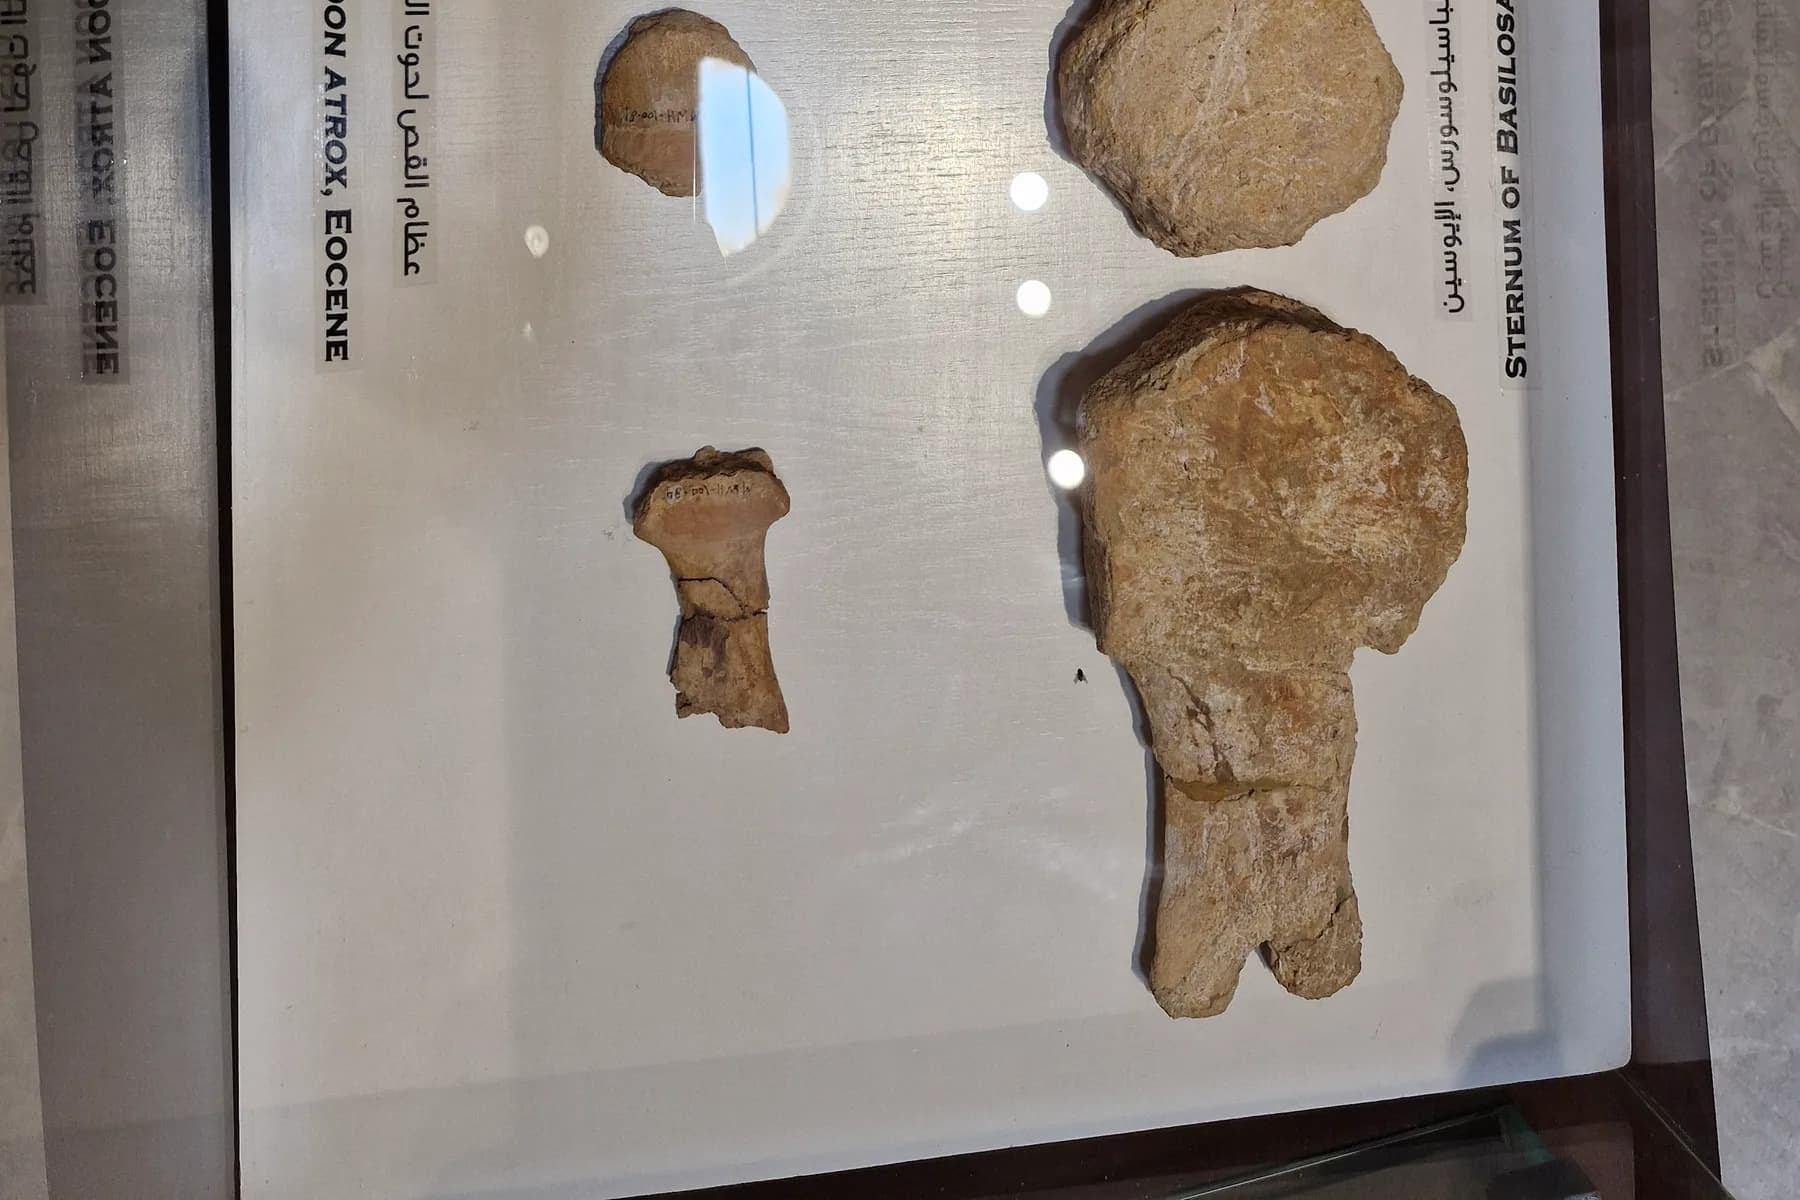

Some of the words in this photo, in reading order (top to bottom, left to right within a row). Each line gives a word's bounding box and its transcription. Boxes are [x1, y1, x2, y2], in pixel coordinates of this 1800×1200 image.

[397, 25, 430, 99] لحوت
[320, 65, 347, 196] ATROX,
[397, 109, 430, 188] القص
[1501, 166, 1520, 209] OF
[397, 198, 429, 276] عظام
[1434, 201, 1464, 313] الإيوسين
[325, 209, 352, 362] EOCENE
[1503, 219, 1527, 378] STERNUM
